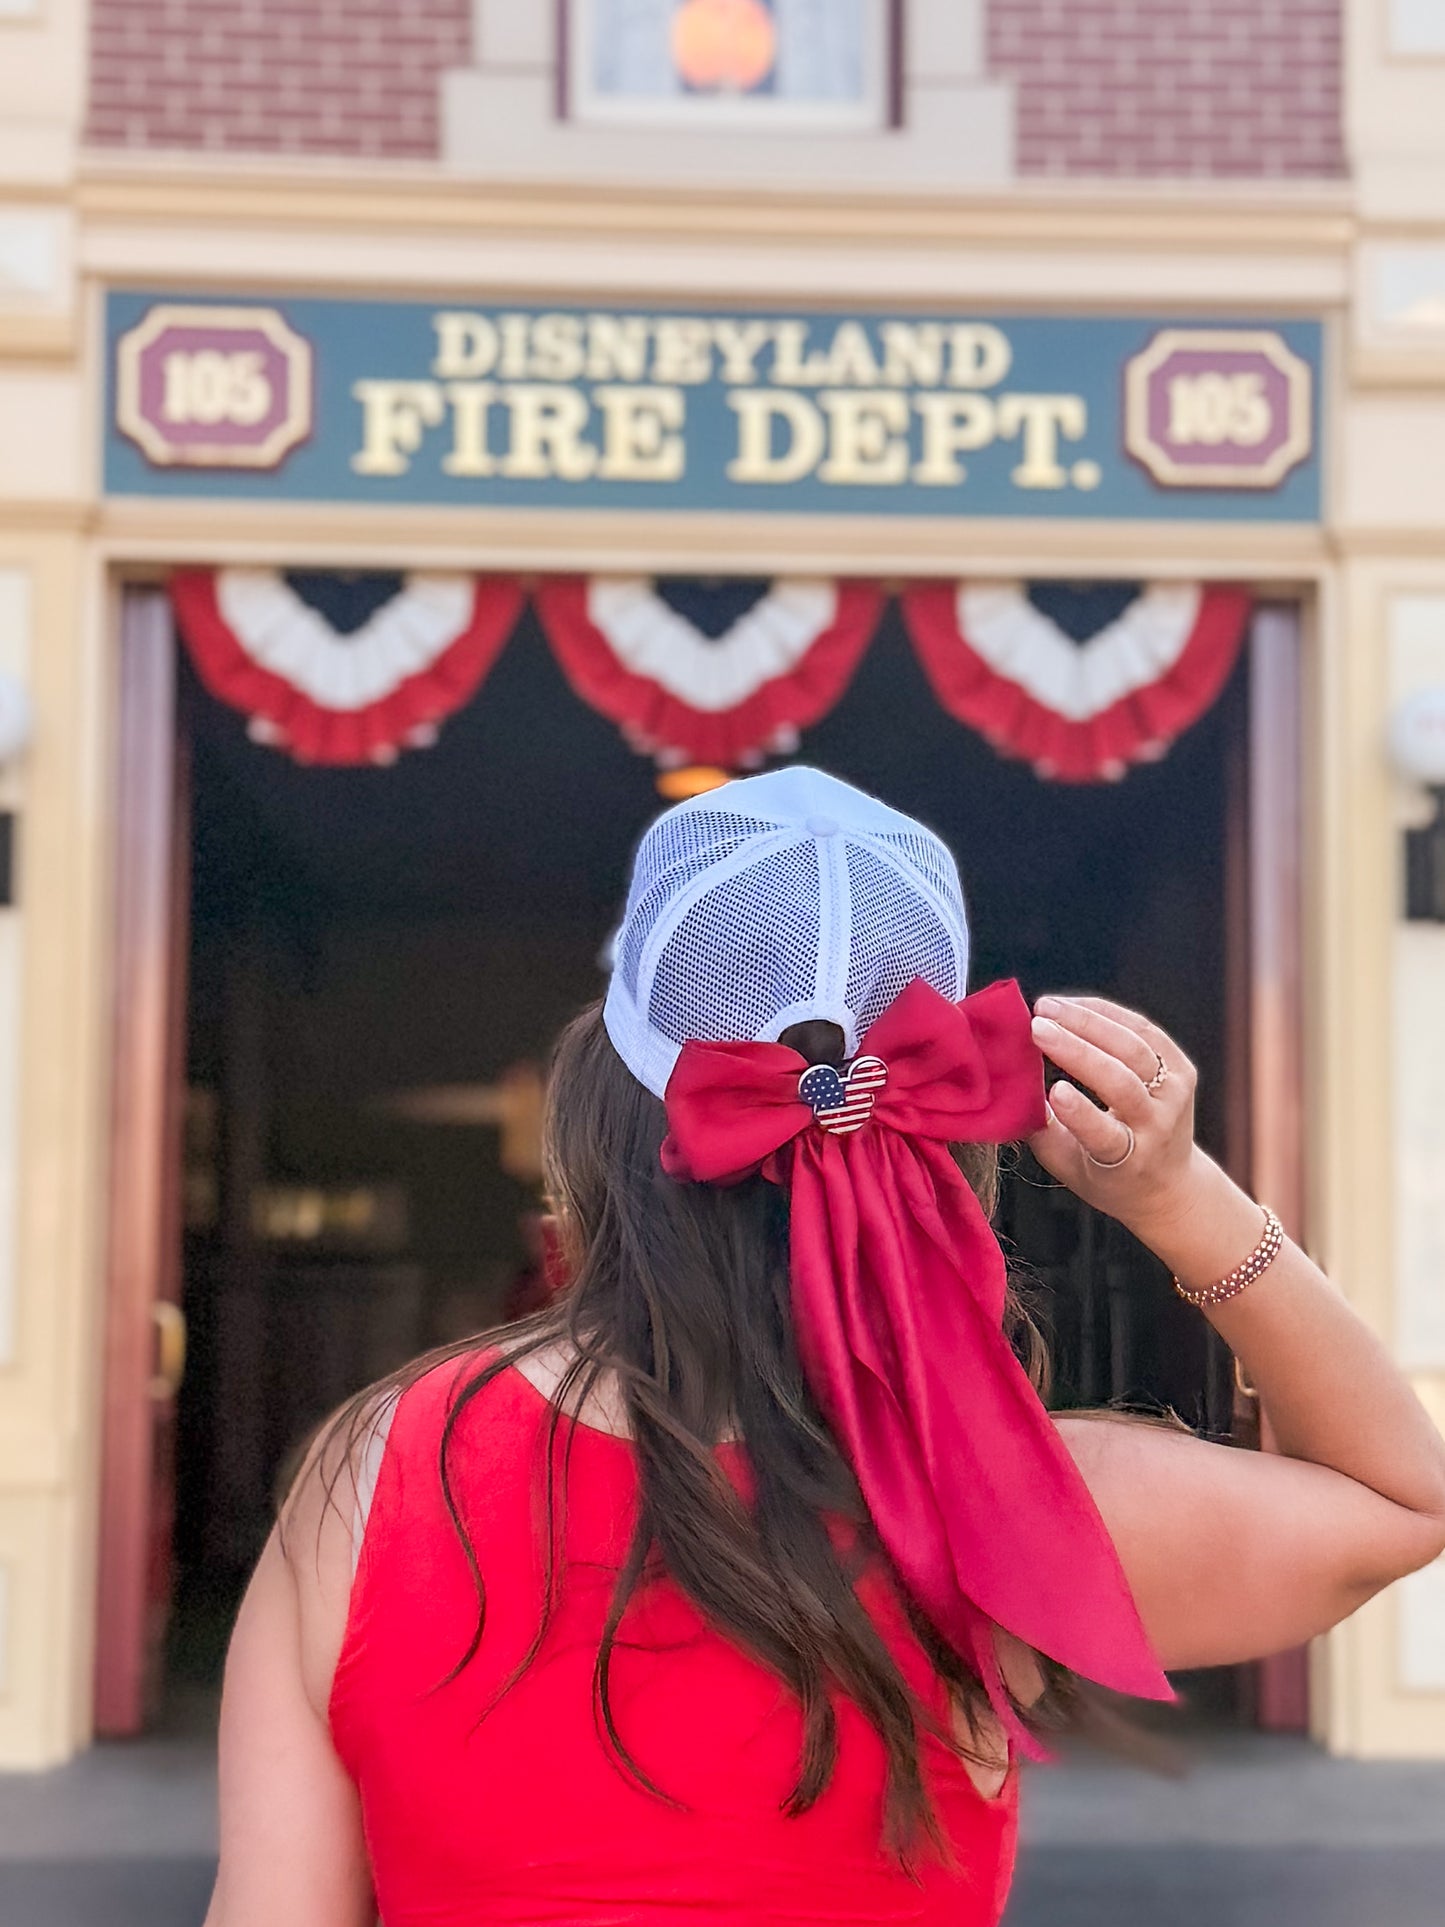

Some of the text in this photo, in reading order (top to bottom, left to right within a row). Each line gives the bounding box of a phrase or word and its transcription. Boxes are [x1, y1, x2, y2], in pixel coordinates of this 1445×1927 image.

[162, 350, 272, 425] 105
[432, 311, 1012, 388] DISNEYLAND
[352, 379, 1102, 490] FIRE DEPT.
[1167, 372, 1272, 446] 105
